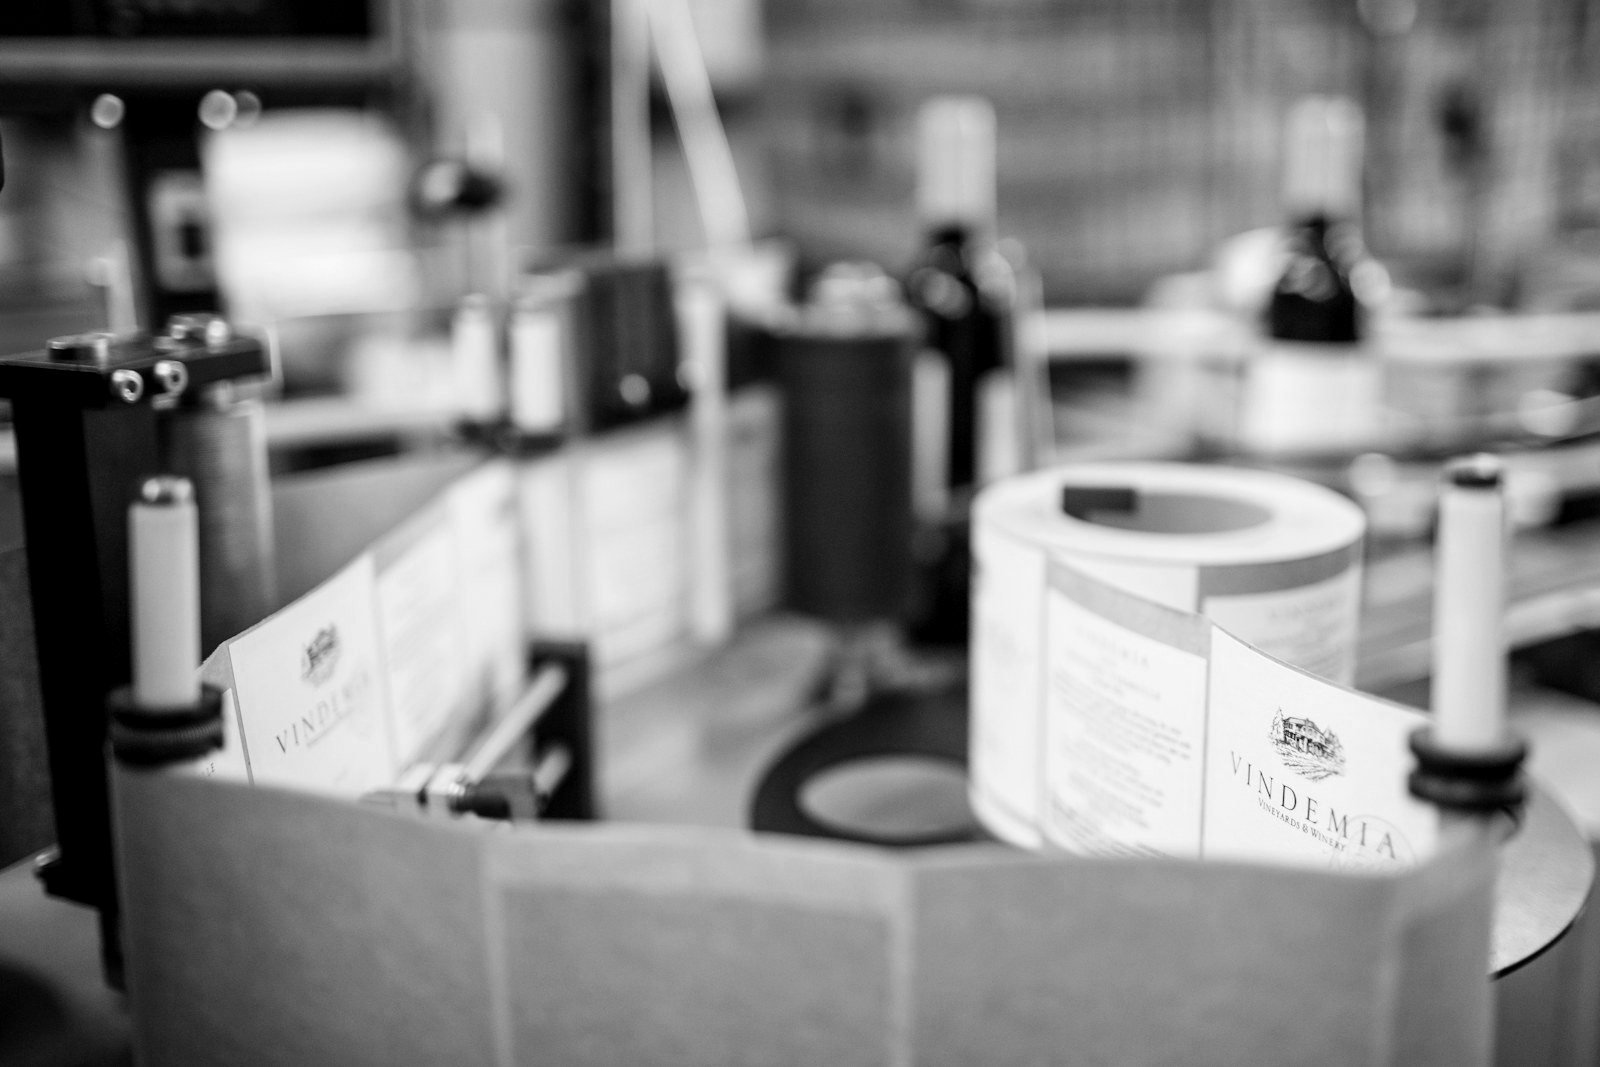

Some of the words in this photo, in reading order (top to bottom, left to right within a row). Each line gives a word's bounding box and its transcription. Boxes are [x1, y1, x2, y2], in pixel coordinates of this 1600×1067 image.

[1231, 750, 1396, 860] VINDEMIA
[1258, 797, 1301, 830] VINEYARDS
[1302, 823, 1310, 835] &
[1311, 827, 1346, 852] WINERY
